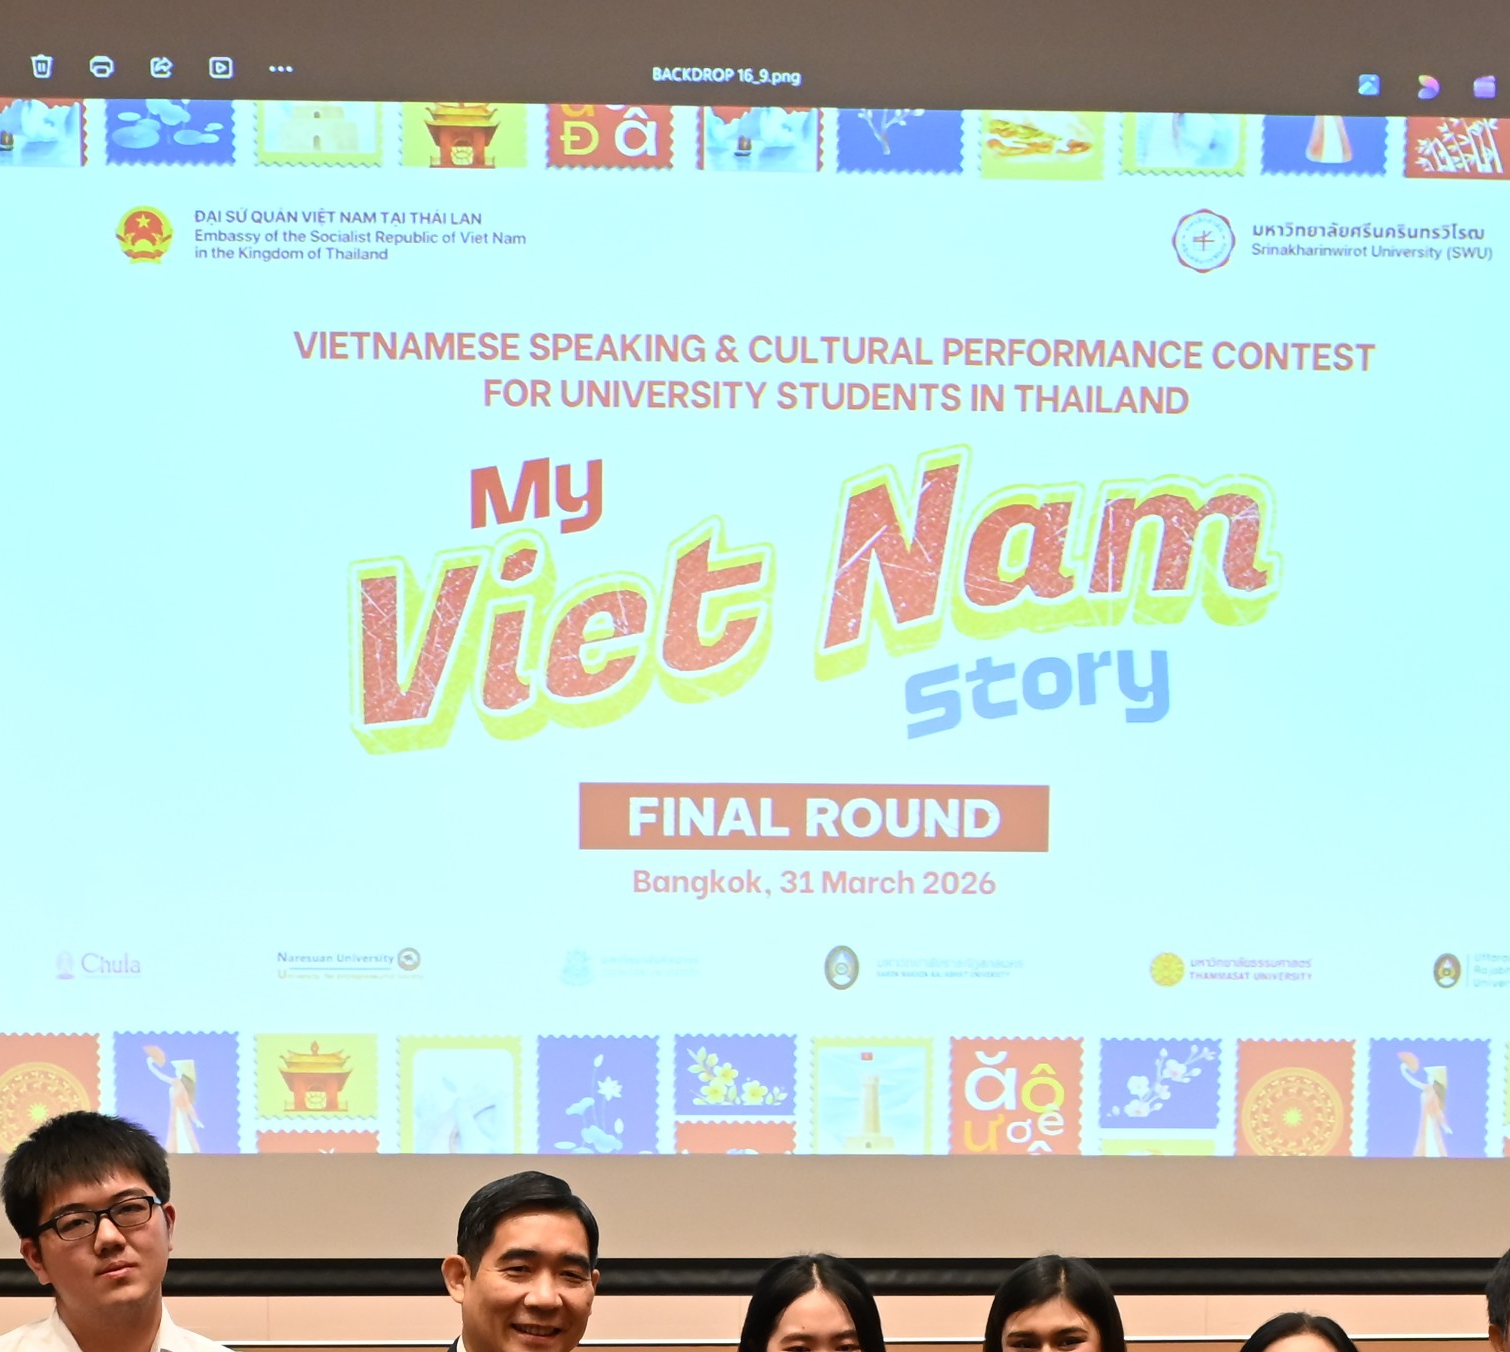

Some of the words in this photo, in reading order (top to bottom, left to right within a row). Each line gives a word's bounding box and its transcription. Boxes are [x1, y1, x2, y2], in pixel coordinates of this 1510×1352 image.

[652, 66, 735, 82] BACKDROP
[737, 67, 802, 86] 16_9.png
[339, 211, 376, 223] NAM
[379, 211, 405, 226] TẠI
[450, 212, 481, 225] LAN
[194, 228, 260, 244] Embassy
[264, 229, 278, 242] of
[282, 229, 306, 242] the
[310, 229, 371, 243] Socialist
[375, 230, 438, 245] Republic
[441, 231, 455, 243] of
[459, 231, 488, 244] Viet
[492, 231, 526, 244] Nam
[194, 246, 207, 258] in
[210, 246, 234, 259] the
[238, 246, 304, 262] Kingdom
[307, 247, 321, 259] of
[325, 246, 388, 260] Thailand
[1251, 242, 1367, 257] Srinakharinwirot
[1371, 244, 1442, 260] University
[1446, 246, 1492, 261] (SWU)
[293, 330, 519, 360] VIETNAMESE
[529, 332, 705, 362] SPEAKING
[714, 334, 739, 362] &
[748, 335, 933, 365] CULTURAL
[942, 337, 1203, 369] PERFORMANCE
[1211, 340, 1375, 371] CONTEST
[484, 378, 551, 407] FOR
[560, 379, 767, 409] UNIVERSITY
[776, 381, 961, 411] STUDENTS
[971, 383, 1004, 411] IN
[1013, 384, 1189, 414] THAILAND
[470, 457, 602, 534] My
[357, 536, 766, 730] Viet
[821, 462, 1271, 651] Nam
[629, 796, 790, 836] FINAL
[805, 797, 1000, 838] ROUND
[633, 868, 771, 900] Bangkok,
[779, 869, 814, 893] 31
[821, 869, 914, 894] March
[922, 870, 996, 894] 2026
[81, 953, 141, 975] Chula
[277, 952, 332, 963] Naresuan
[337, 953, 394, 964] University
[1189, 972, 1249, 980] THAMMASAT
[1253, 972, 1312, 981] UNIVERSITY
